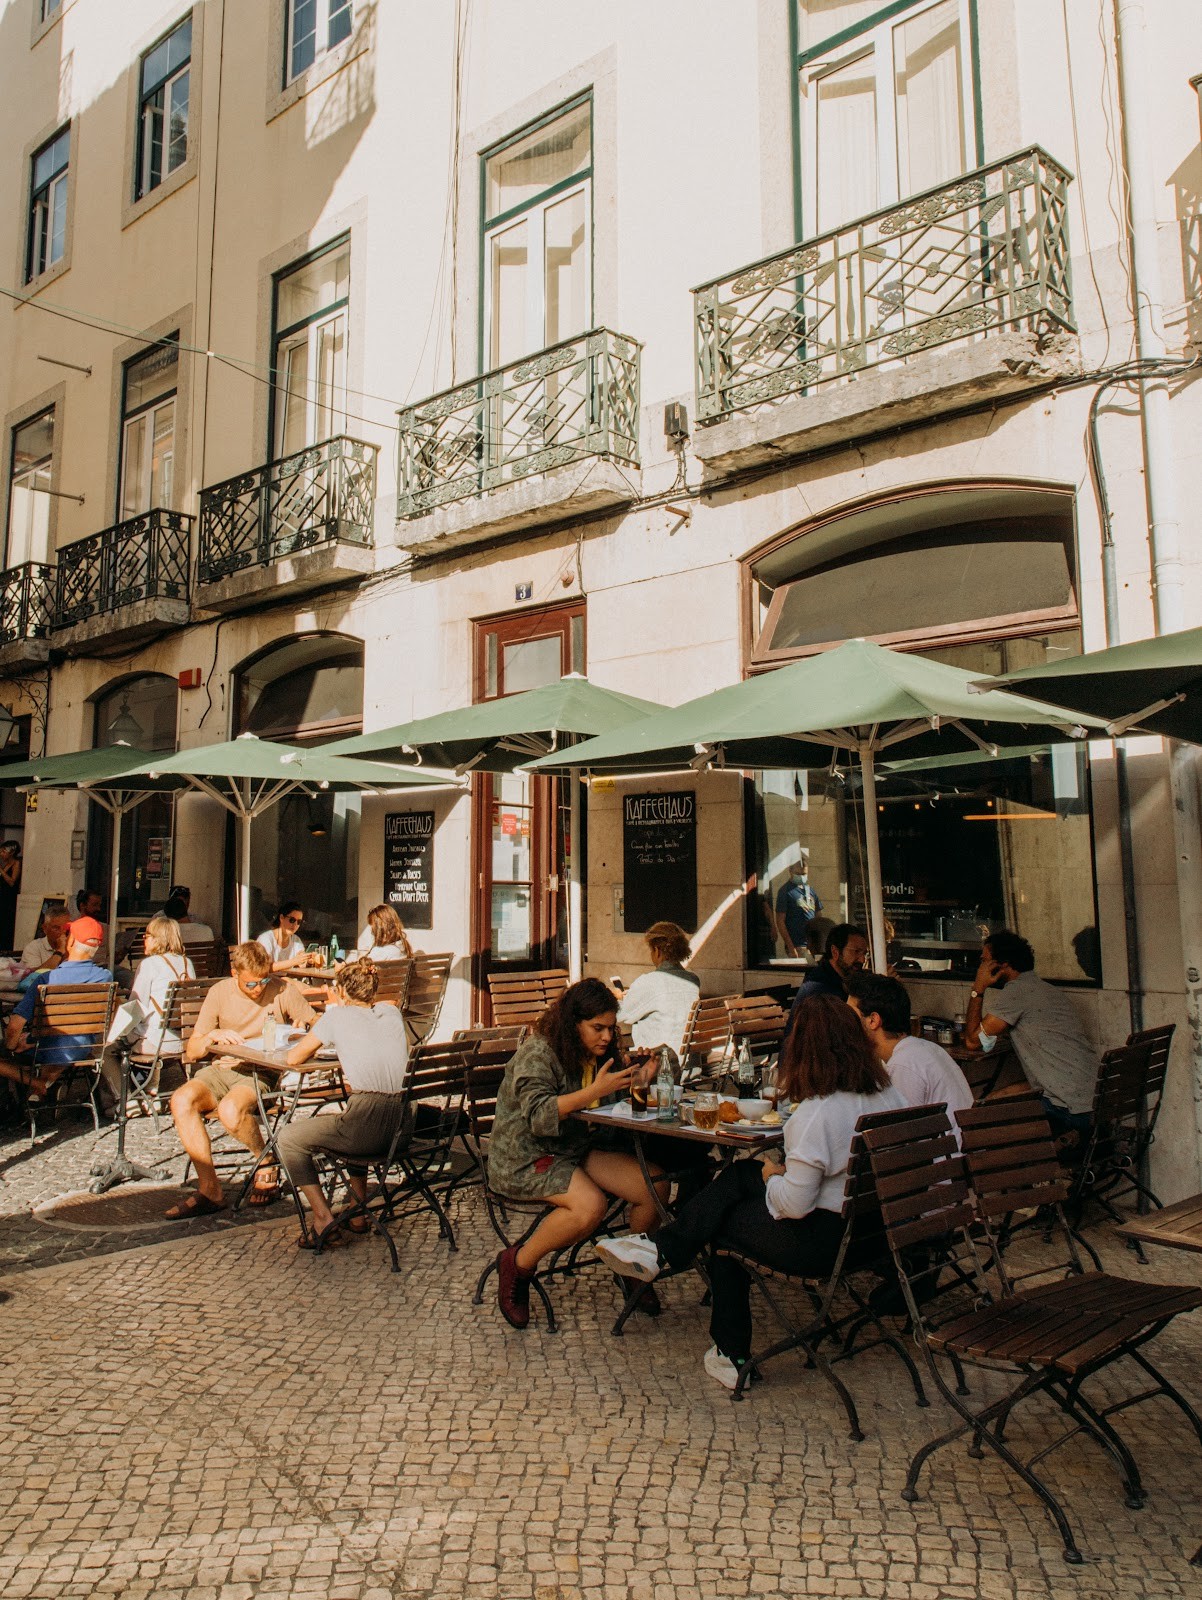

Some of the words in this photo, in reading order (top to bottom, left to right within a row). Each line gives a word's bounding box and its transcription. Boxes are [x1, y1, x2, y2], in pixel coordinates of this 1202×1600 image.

[520, 585, 526, 599] 3
[626, 796, 693, 820] KAFFEEHAUS
[387, 816, 432, 834] KAFFEEHAUS
